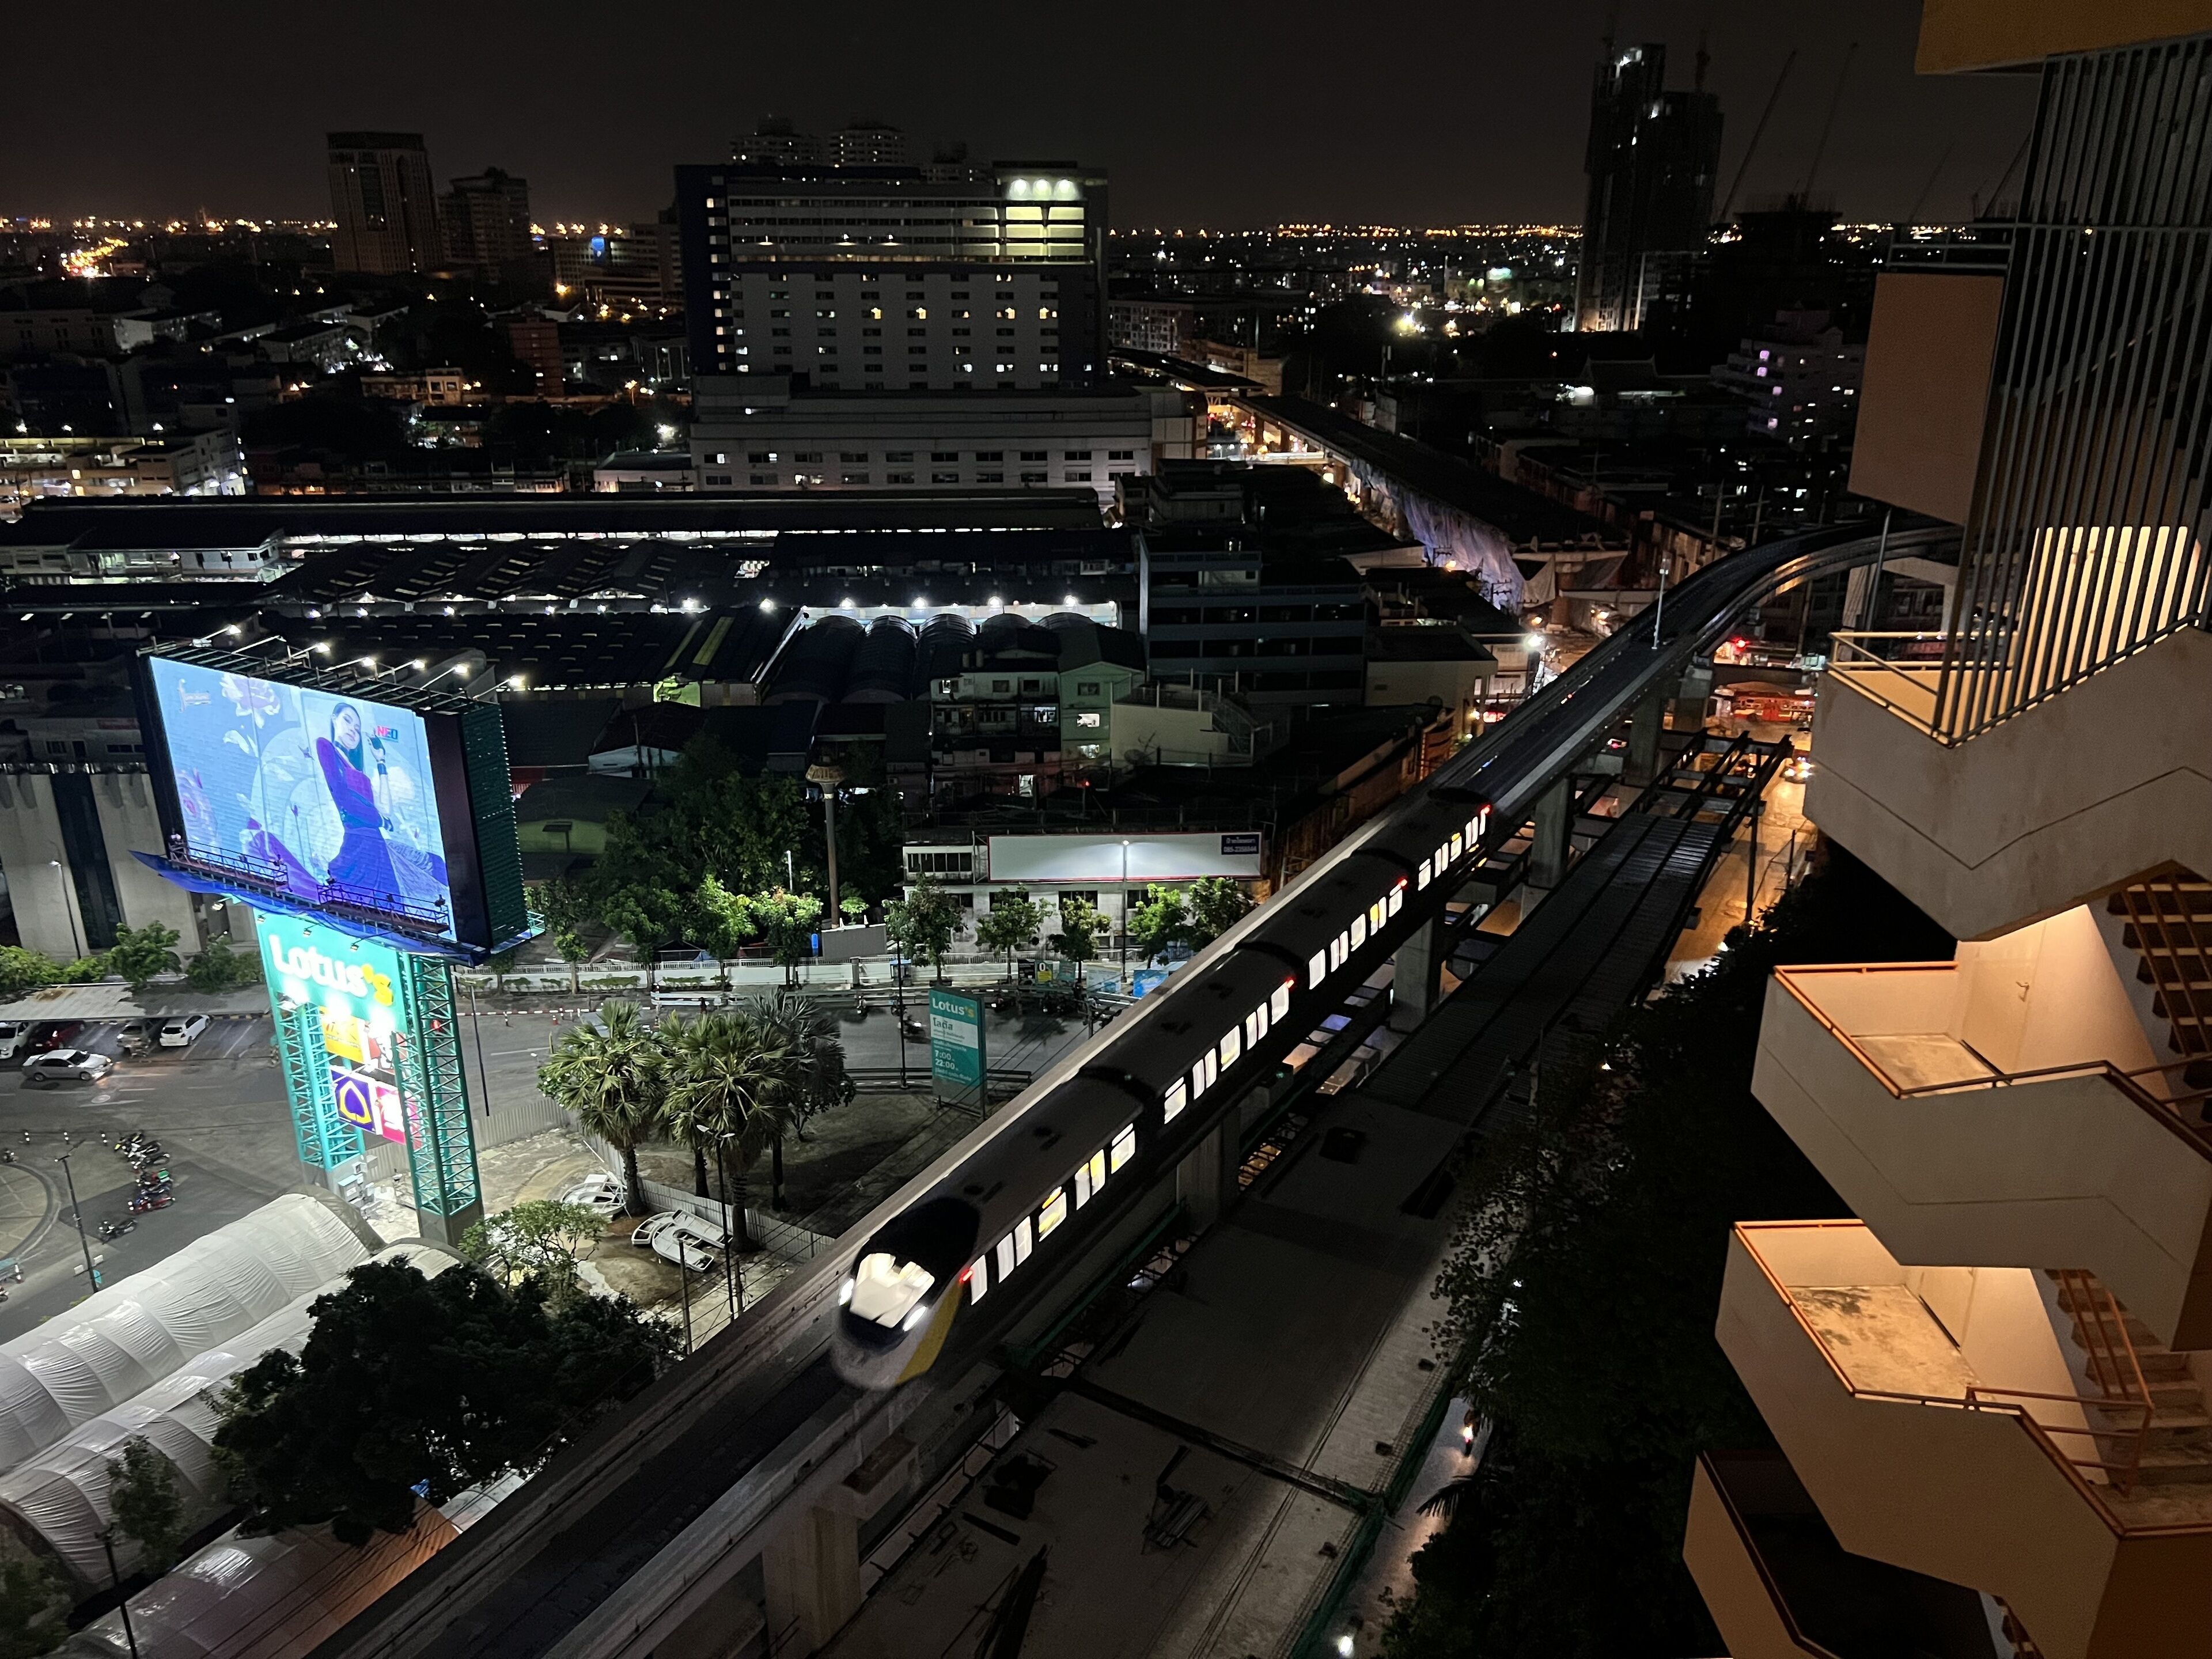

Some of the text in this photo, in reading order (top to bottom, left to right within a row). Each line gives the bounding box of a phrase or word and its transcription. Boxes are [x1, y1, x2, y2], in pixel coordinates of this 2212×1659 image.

[268, 934, 393, 1006] Lotus's
[932, 997, 975, 1017] Lotus's
[933, 1017, 953, 1031] โลตัส
[934, 1050, 952, 1060] 7:00
[935, 1059, 955, 1070] 22:00
